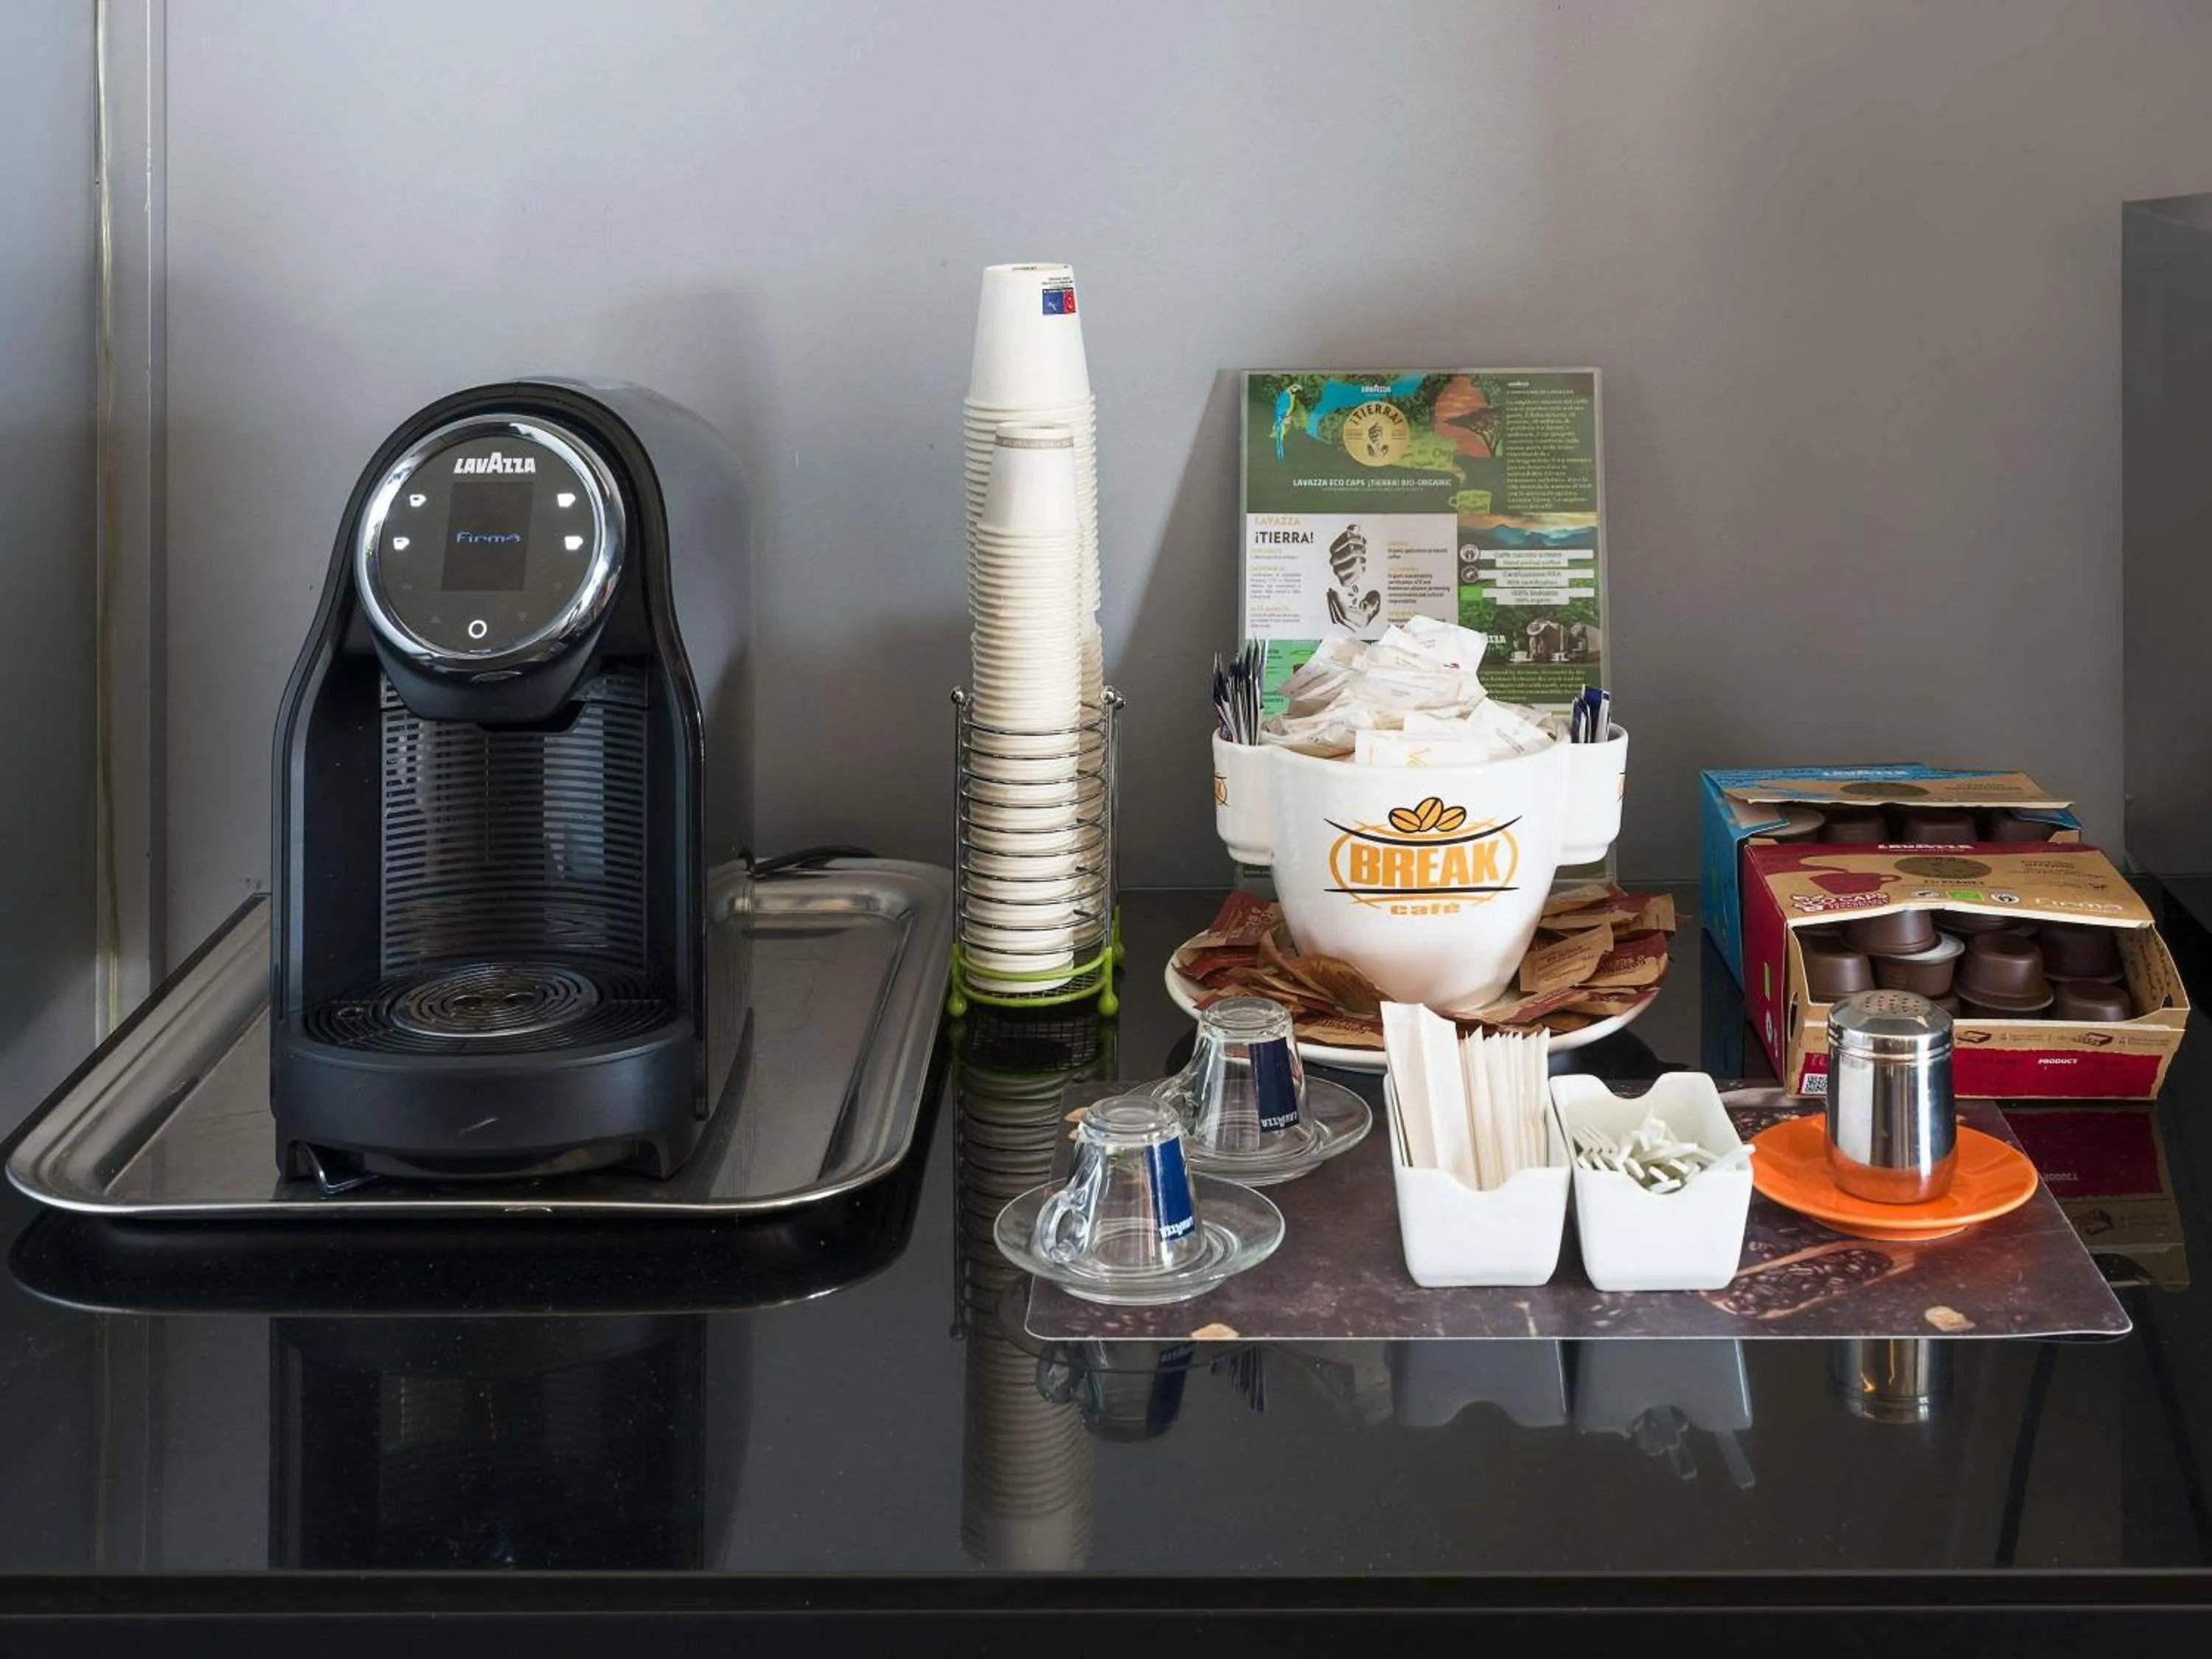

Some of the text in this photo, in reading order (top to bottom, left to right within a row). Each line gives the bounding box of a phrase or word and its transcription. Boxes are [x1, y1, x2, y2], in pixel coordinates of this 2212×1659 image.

[453, 452, 536, 474] LAVAZZA
[1293, 479, 1327, 487] LAVAZZA
[1329, 479, 1343, 487] ECO
[1346, 479, 1365, 487] CAPS
[1255, 517, 1301, 525] LAVAZZA
[456, 531, 521, 543] Firma
[1255, 532, 1314, 543] ¡TIERRA!
[1349, 840, 1499, 888] BREAK
